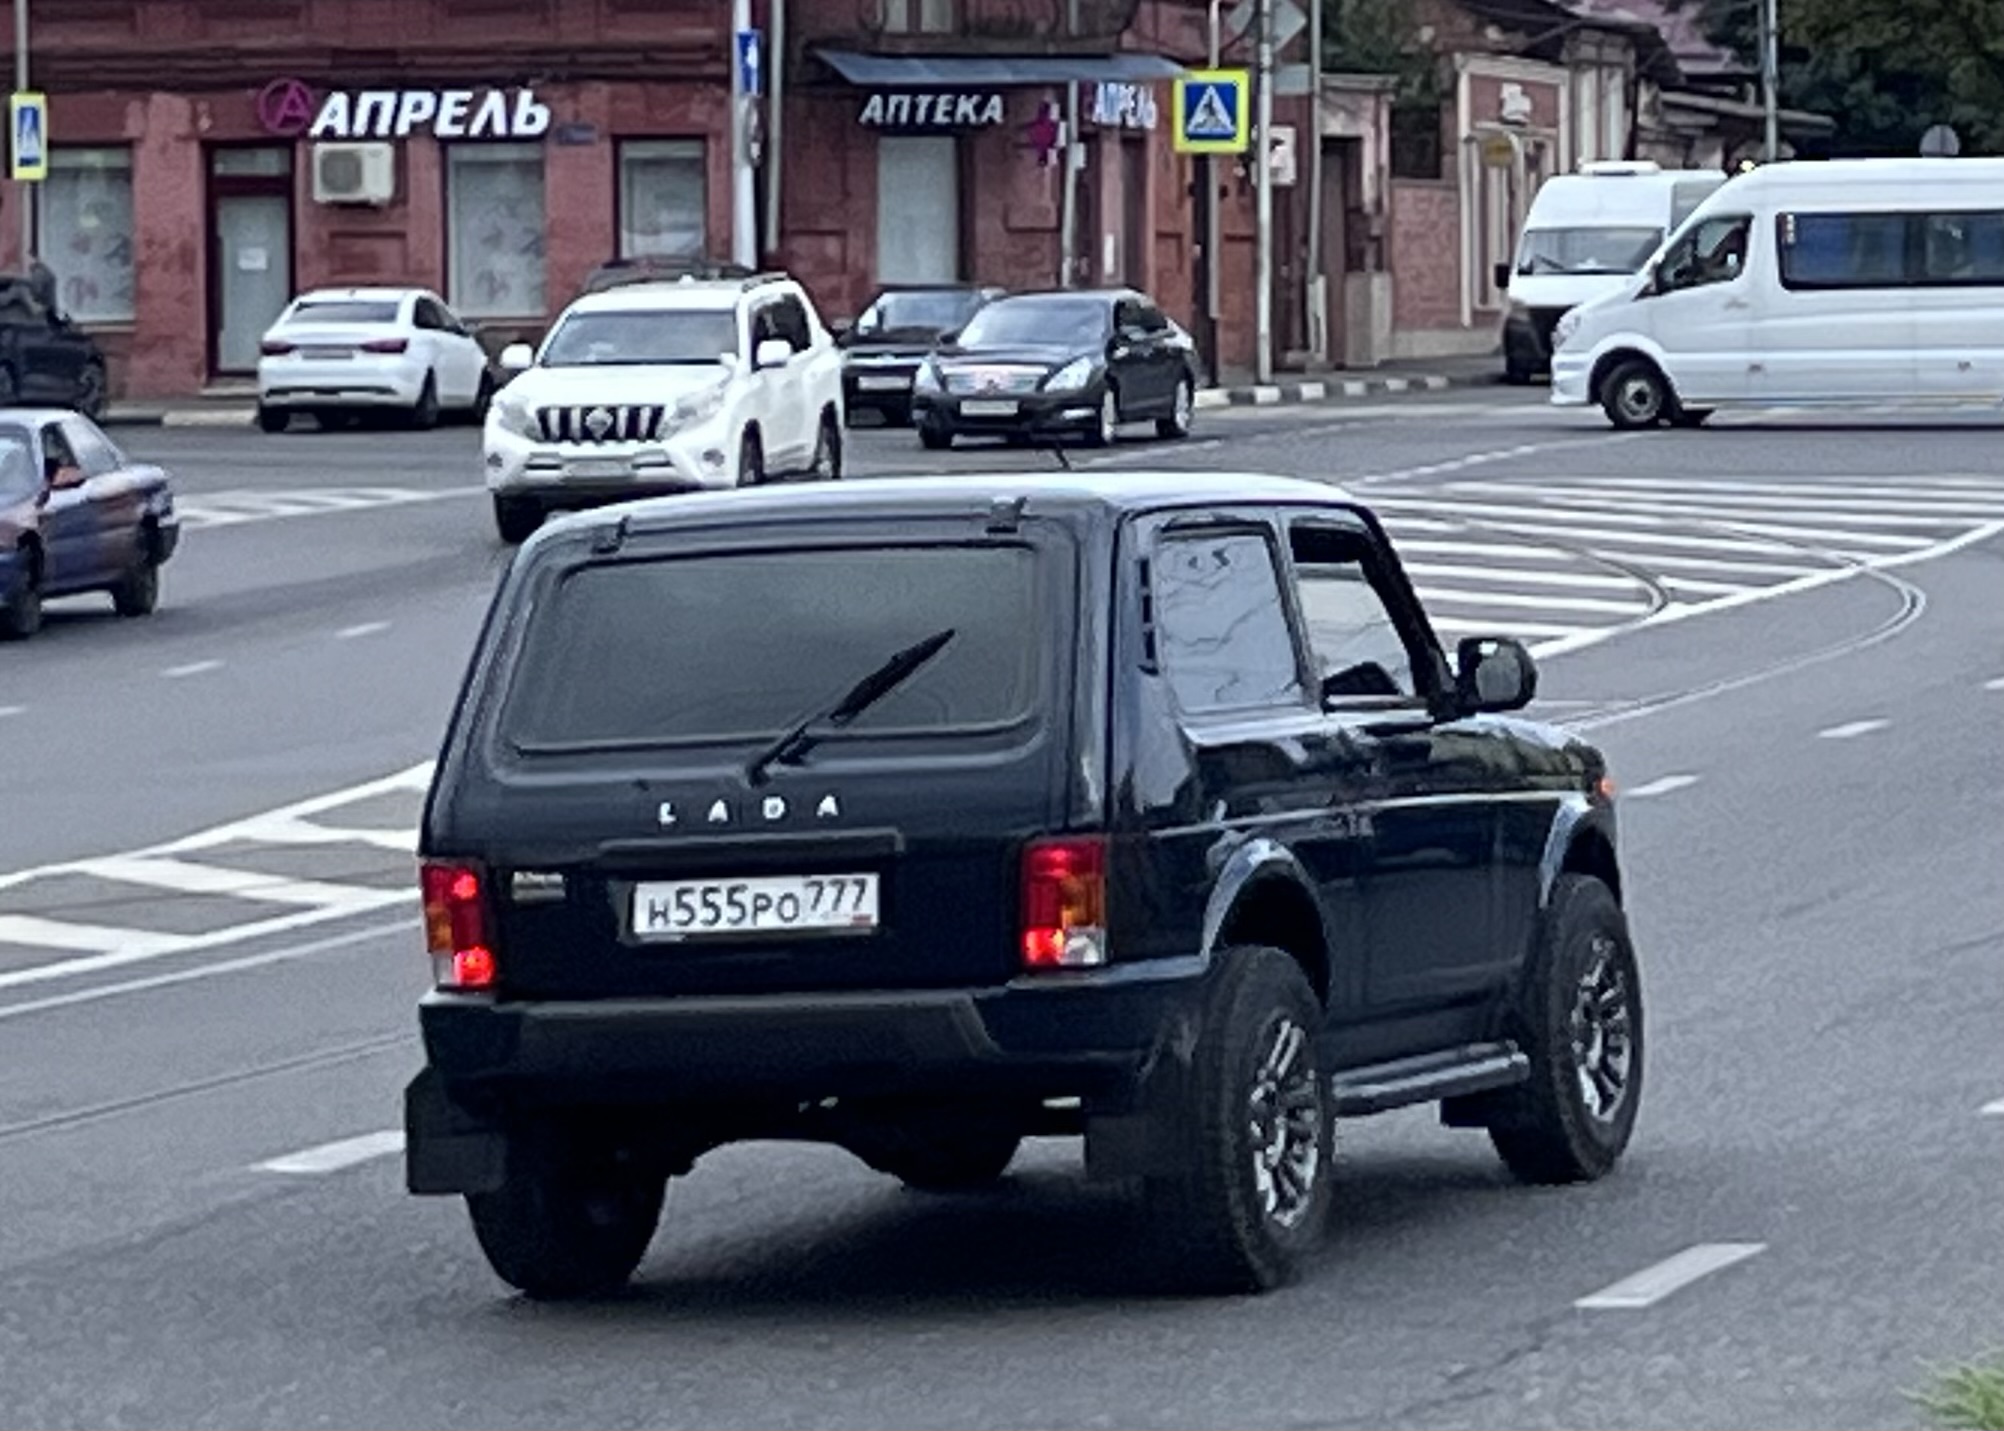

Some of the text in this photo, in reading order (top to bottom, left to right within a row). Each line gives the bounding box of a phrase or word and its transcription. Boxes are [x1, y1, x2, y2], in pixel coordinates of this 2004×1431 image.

[308, 89, 551, 137] АПРЕЛЬ
[857, 93, 1004, 125] АПТЕКА
[658, 795, 840, 825] LADA
